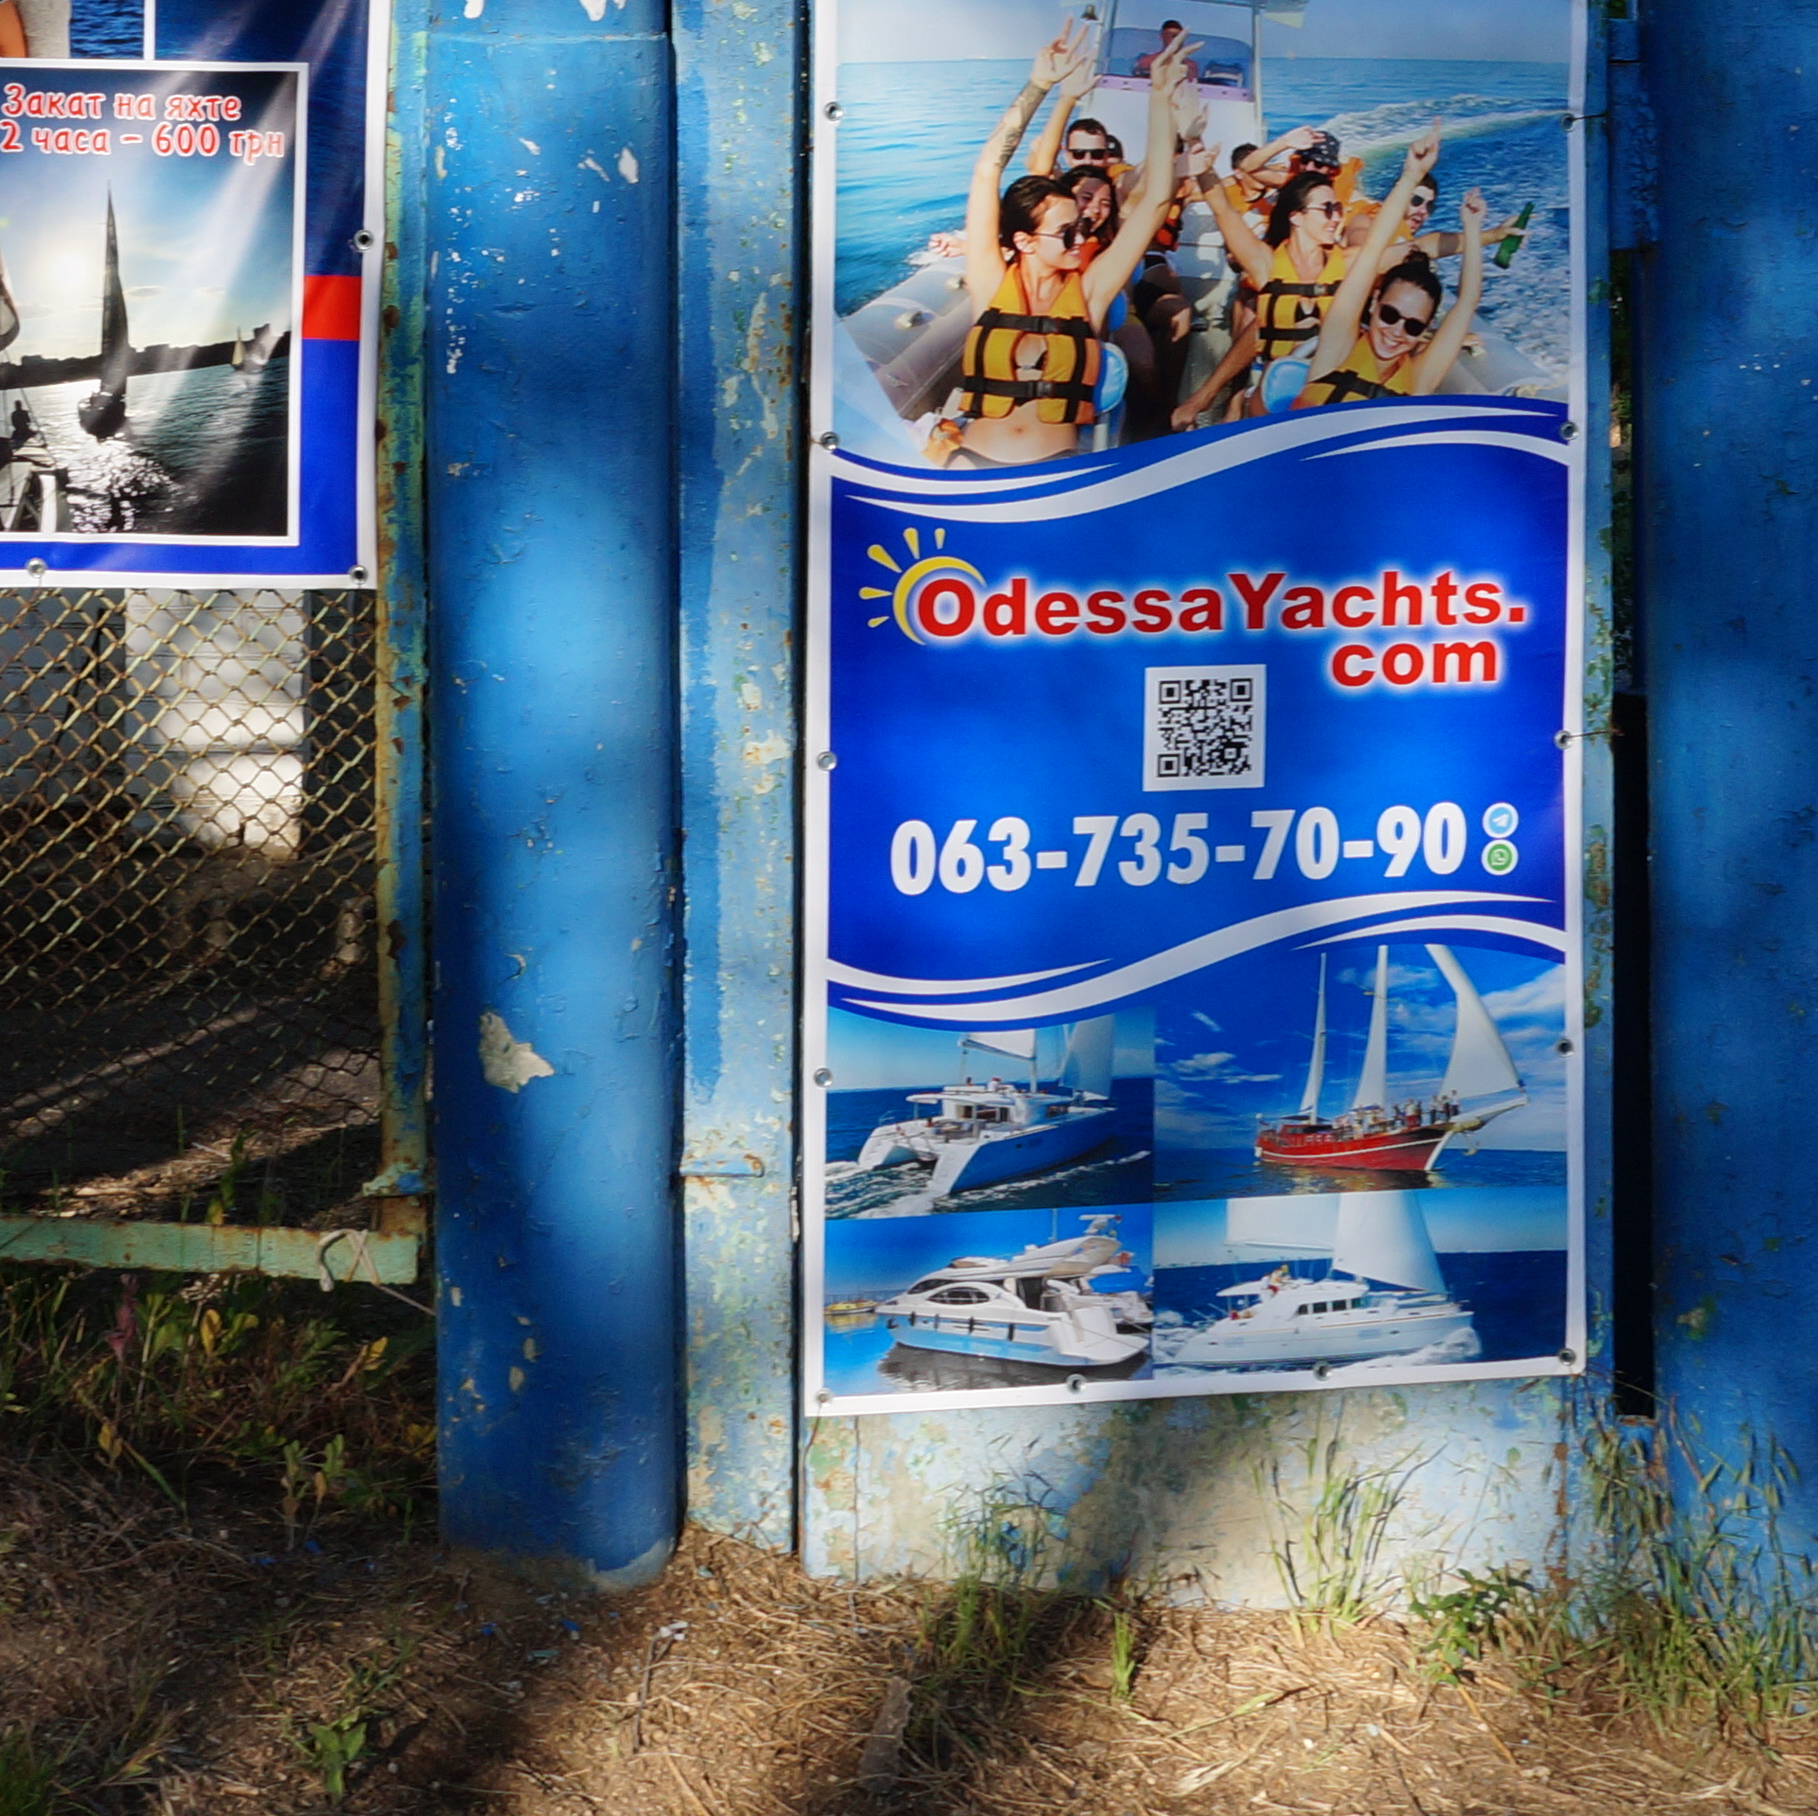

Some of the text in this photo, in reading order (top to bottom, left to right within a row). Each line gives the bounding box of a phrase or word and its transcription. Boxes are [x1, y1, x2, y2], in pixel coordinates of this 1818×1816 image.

[3, 83, 242, 121] Закат на яхте
[32, 126, 110, 155] часа
[152, 124, 219, 156] 600
[229, 129, 285, 165] грн
[916, 570, 1526, 638] OdessaYachts.
[1331, 638, 1498, 687] com
[890, 801, 1468, 897] 063-735-70-90
